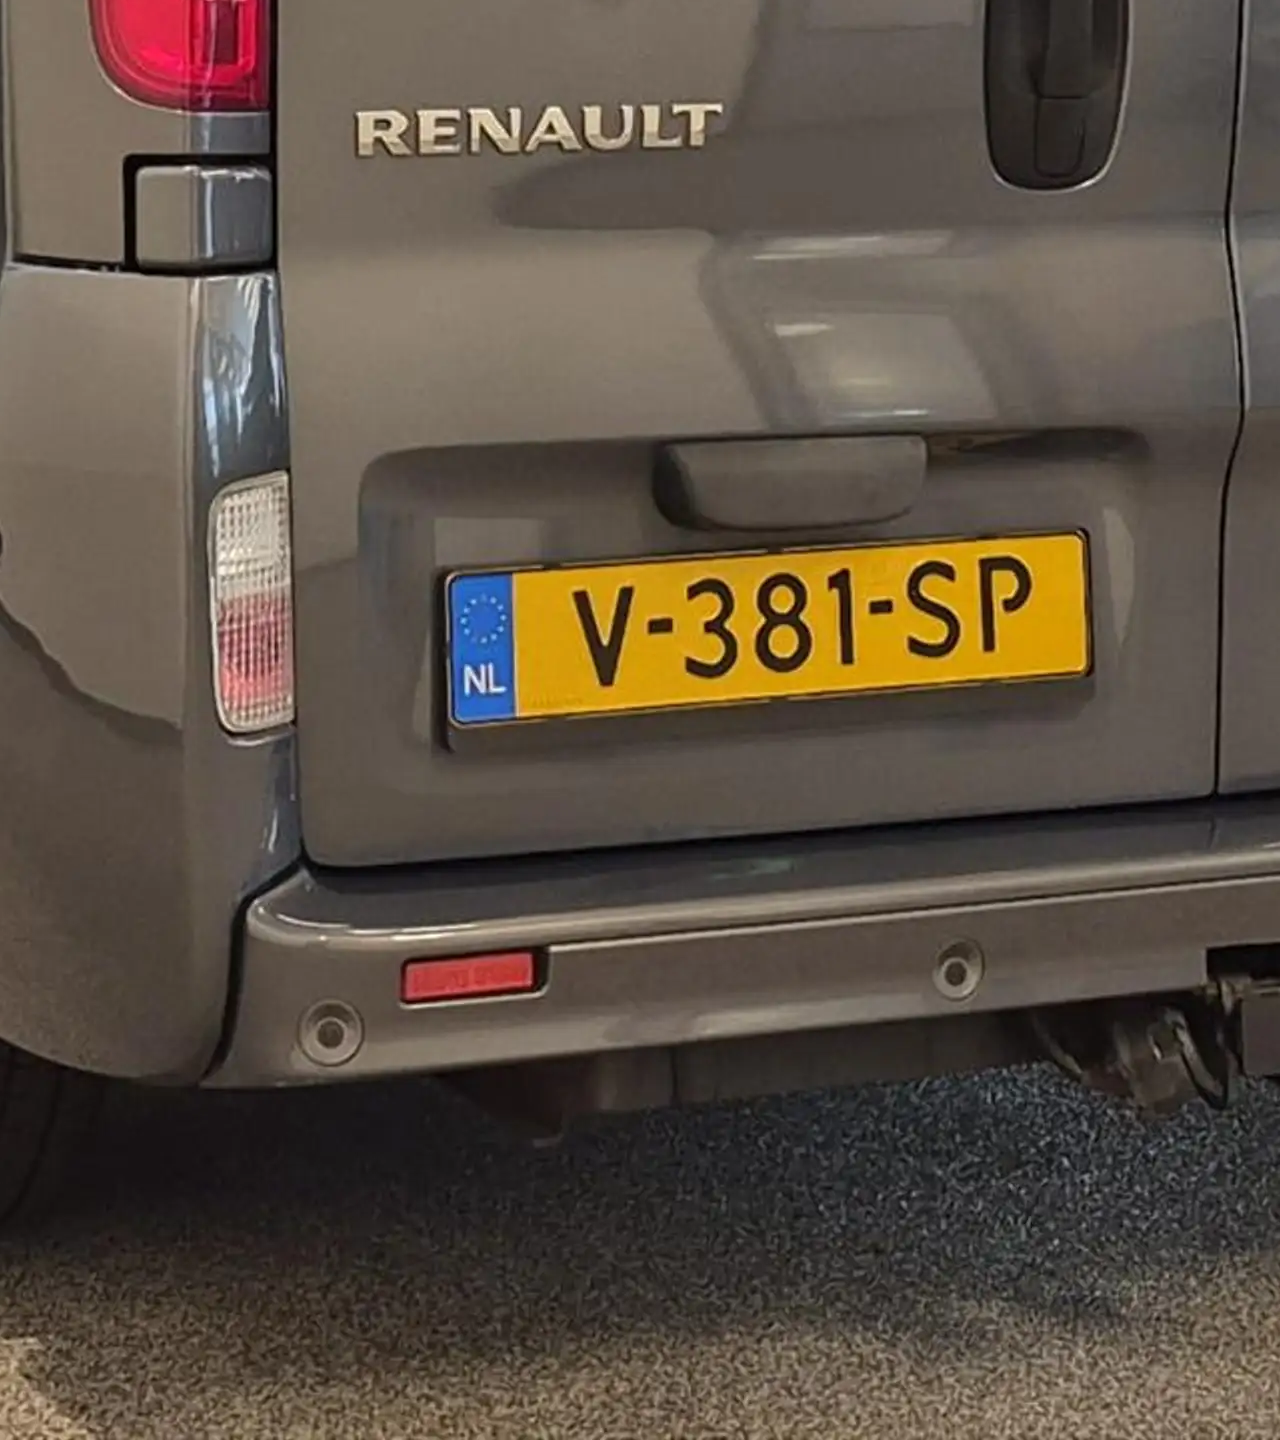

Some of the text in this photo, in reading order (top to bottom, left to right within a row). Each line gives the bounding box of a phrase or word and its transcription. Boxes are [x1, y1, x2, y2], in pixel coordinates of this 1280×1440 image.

[356, 103, 723, 157] RENAULT
[572, 554, 1033, 687] V-381-SP
[463, 663, 507, 698] NL
